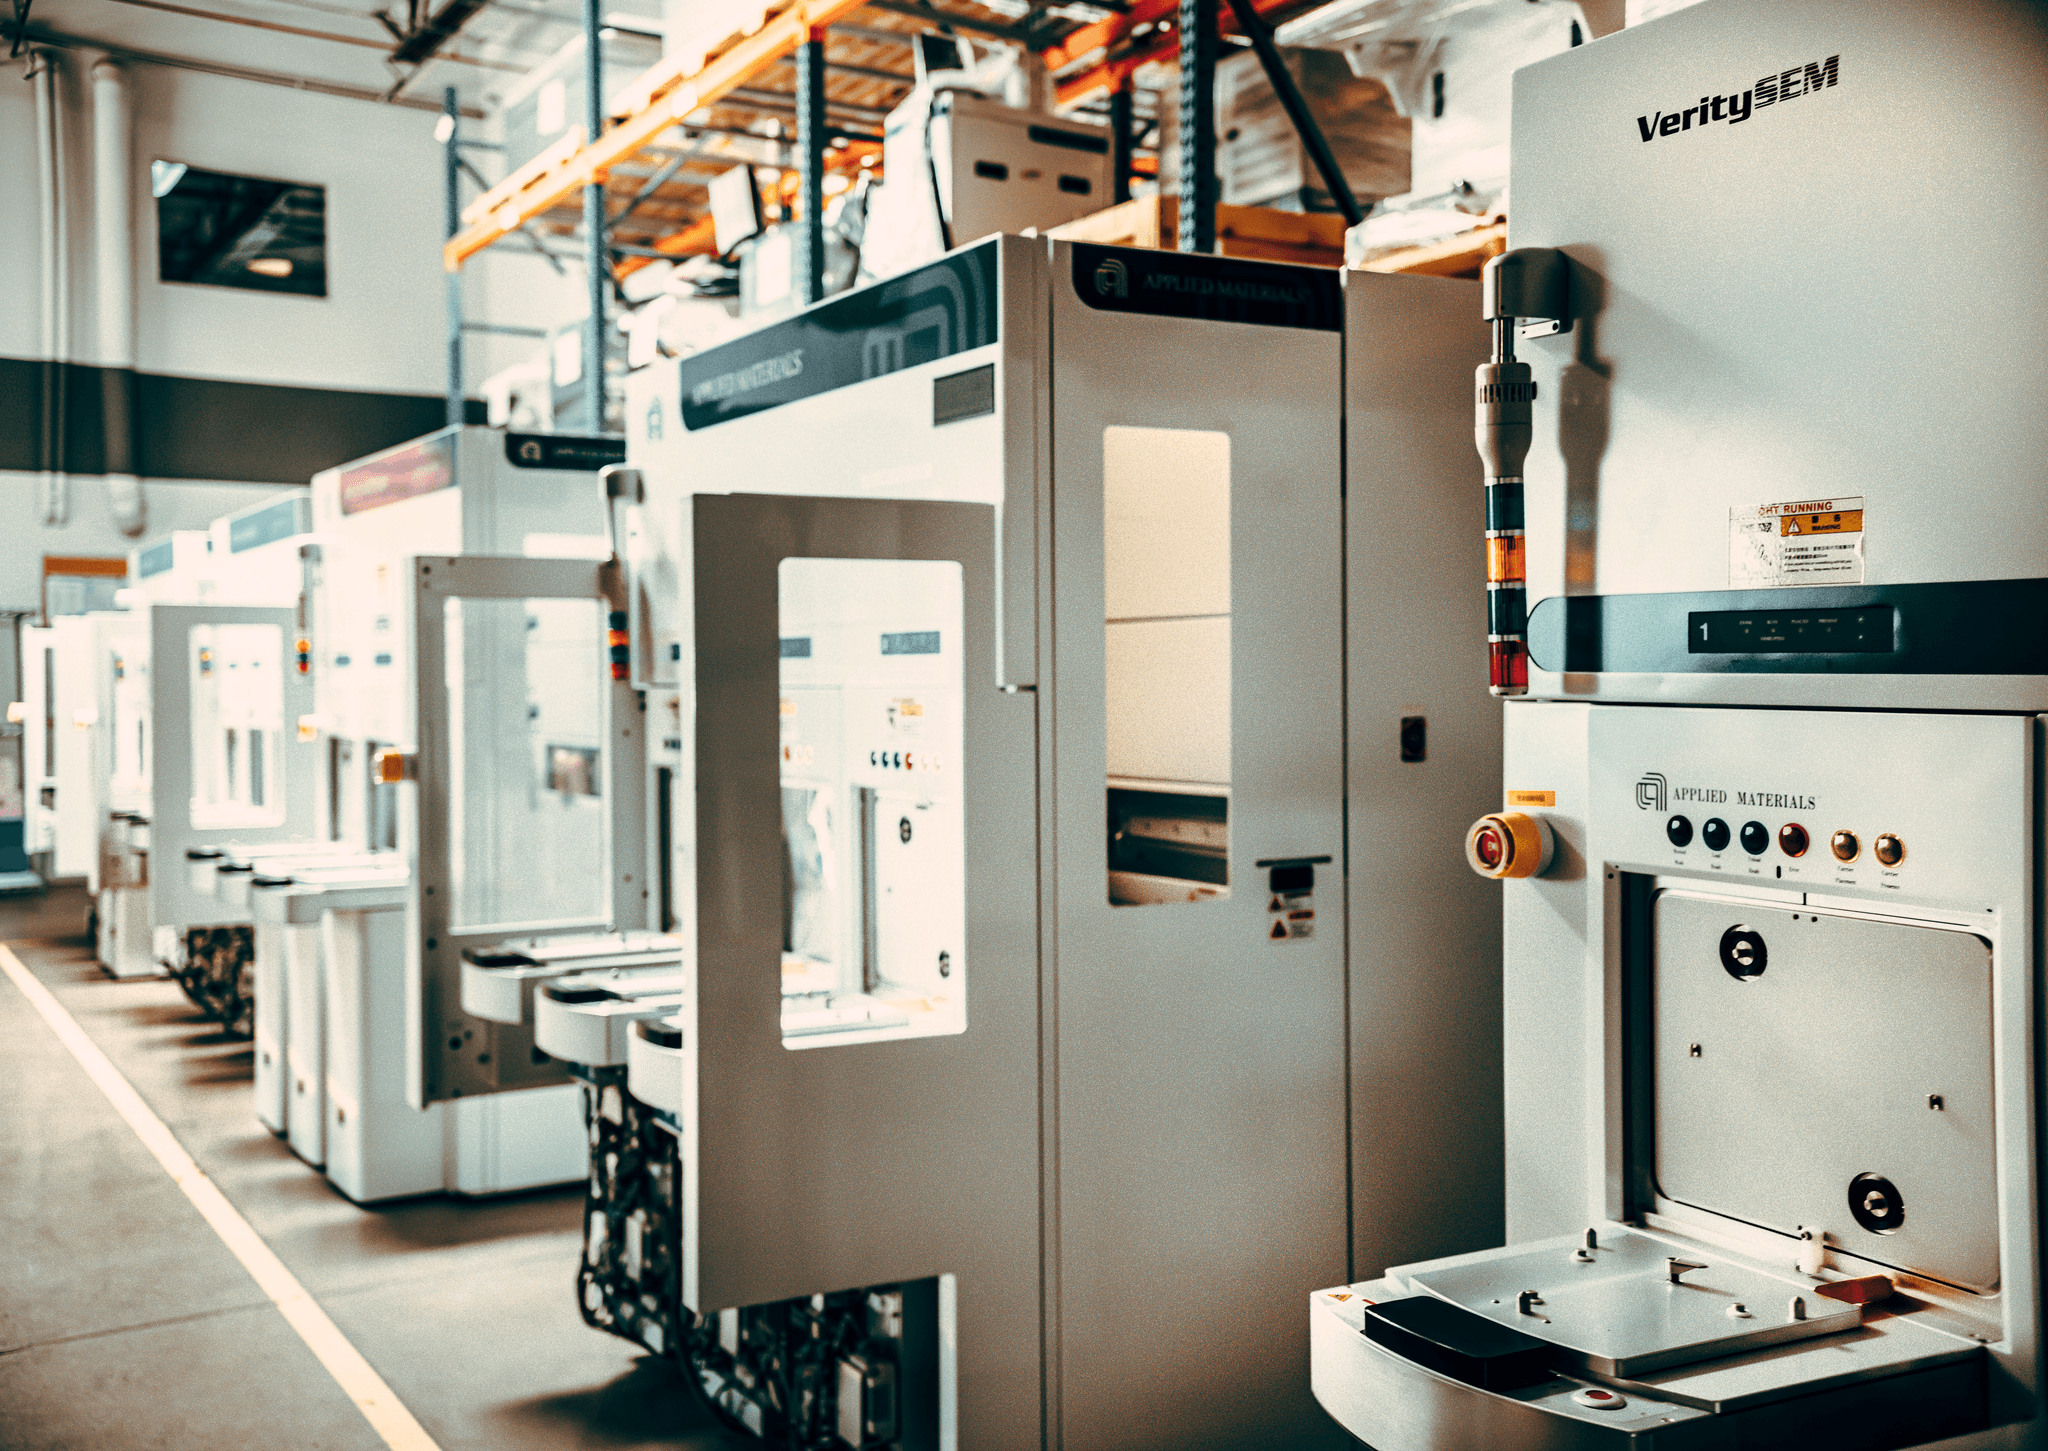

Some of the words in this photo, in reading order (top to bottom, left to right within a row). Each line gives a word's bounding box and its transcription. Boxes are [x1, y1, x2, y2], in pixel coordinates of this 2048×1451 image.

[1637, 54, 1840, 143] VeritySEM
[1783, 501, 1833, 514] RUNNING
[1699, 622, 1708, 641] 1
[1672, 787, 1727, 804] APPLIED
[1737, 791, 1816, 810] MATERIALS
